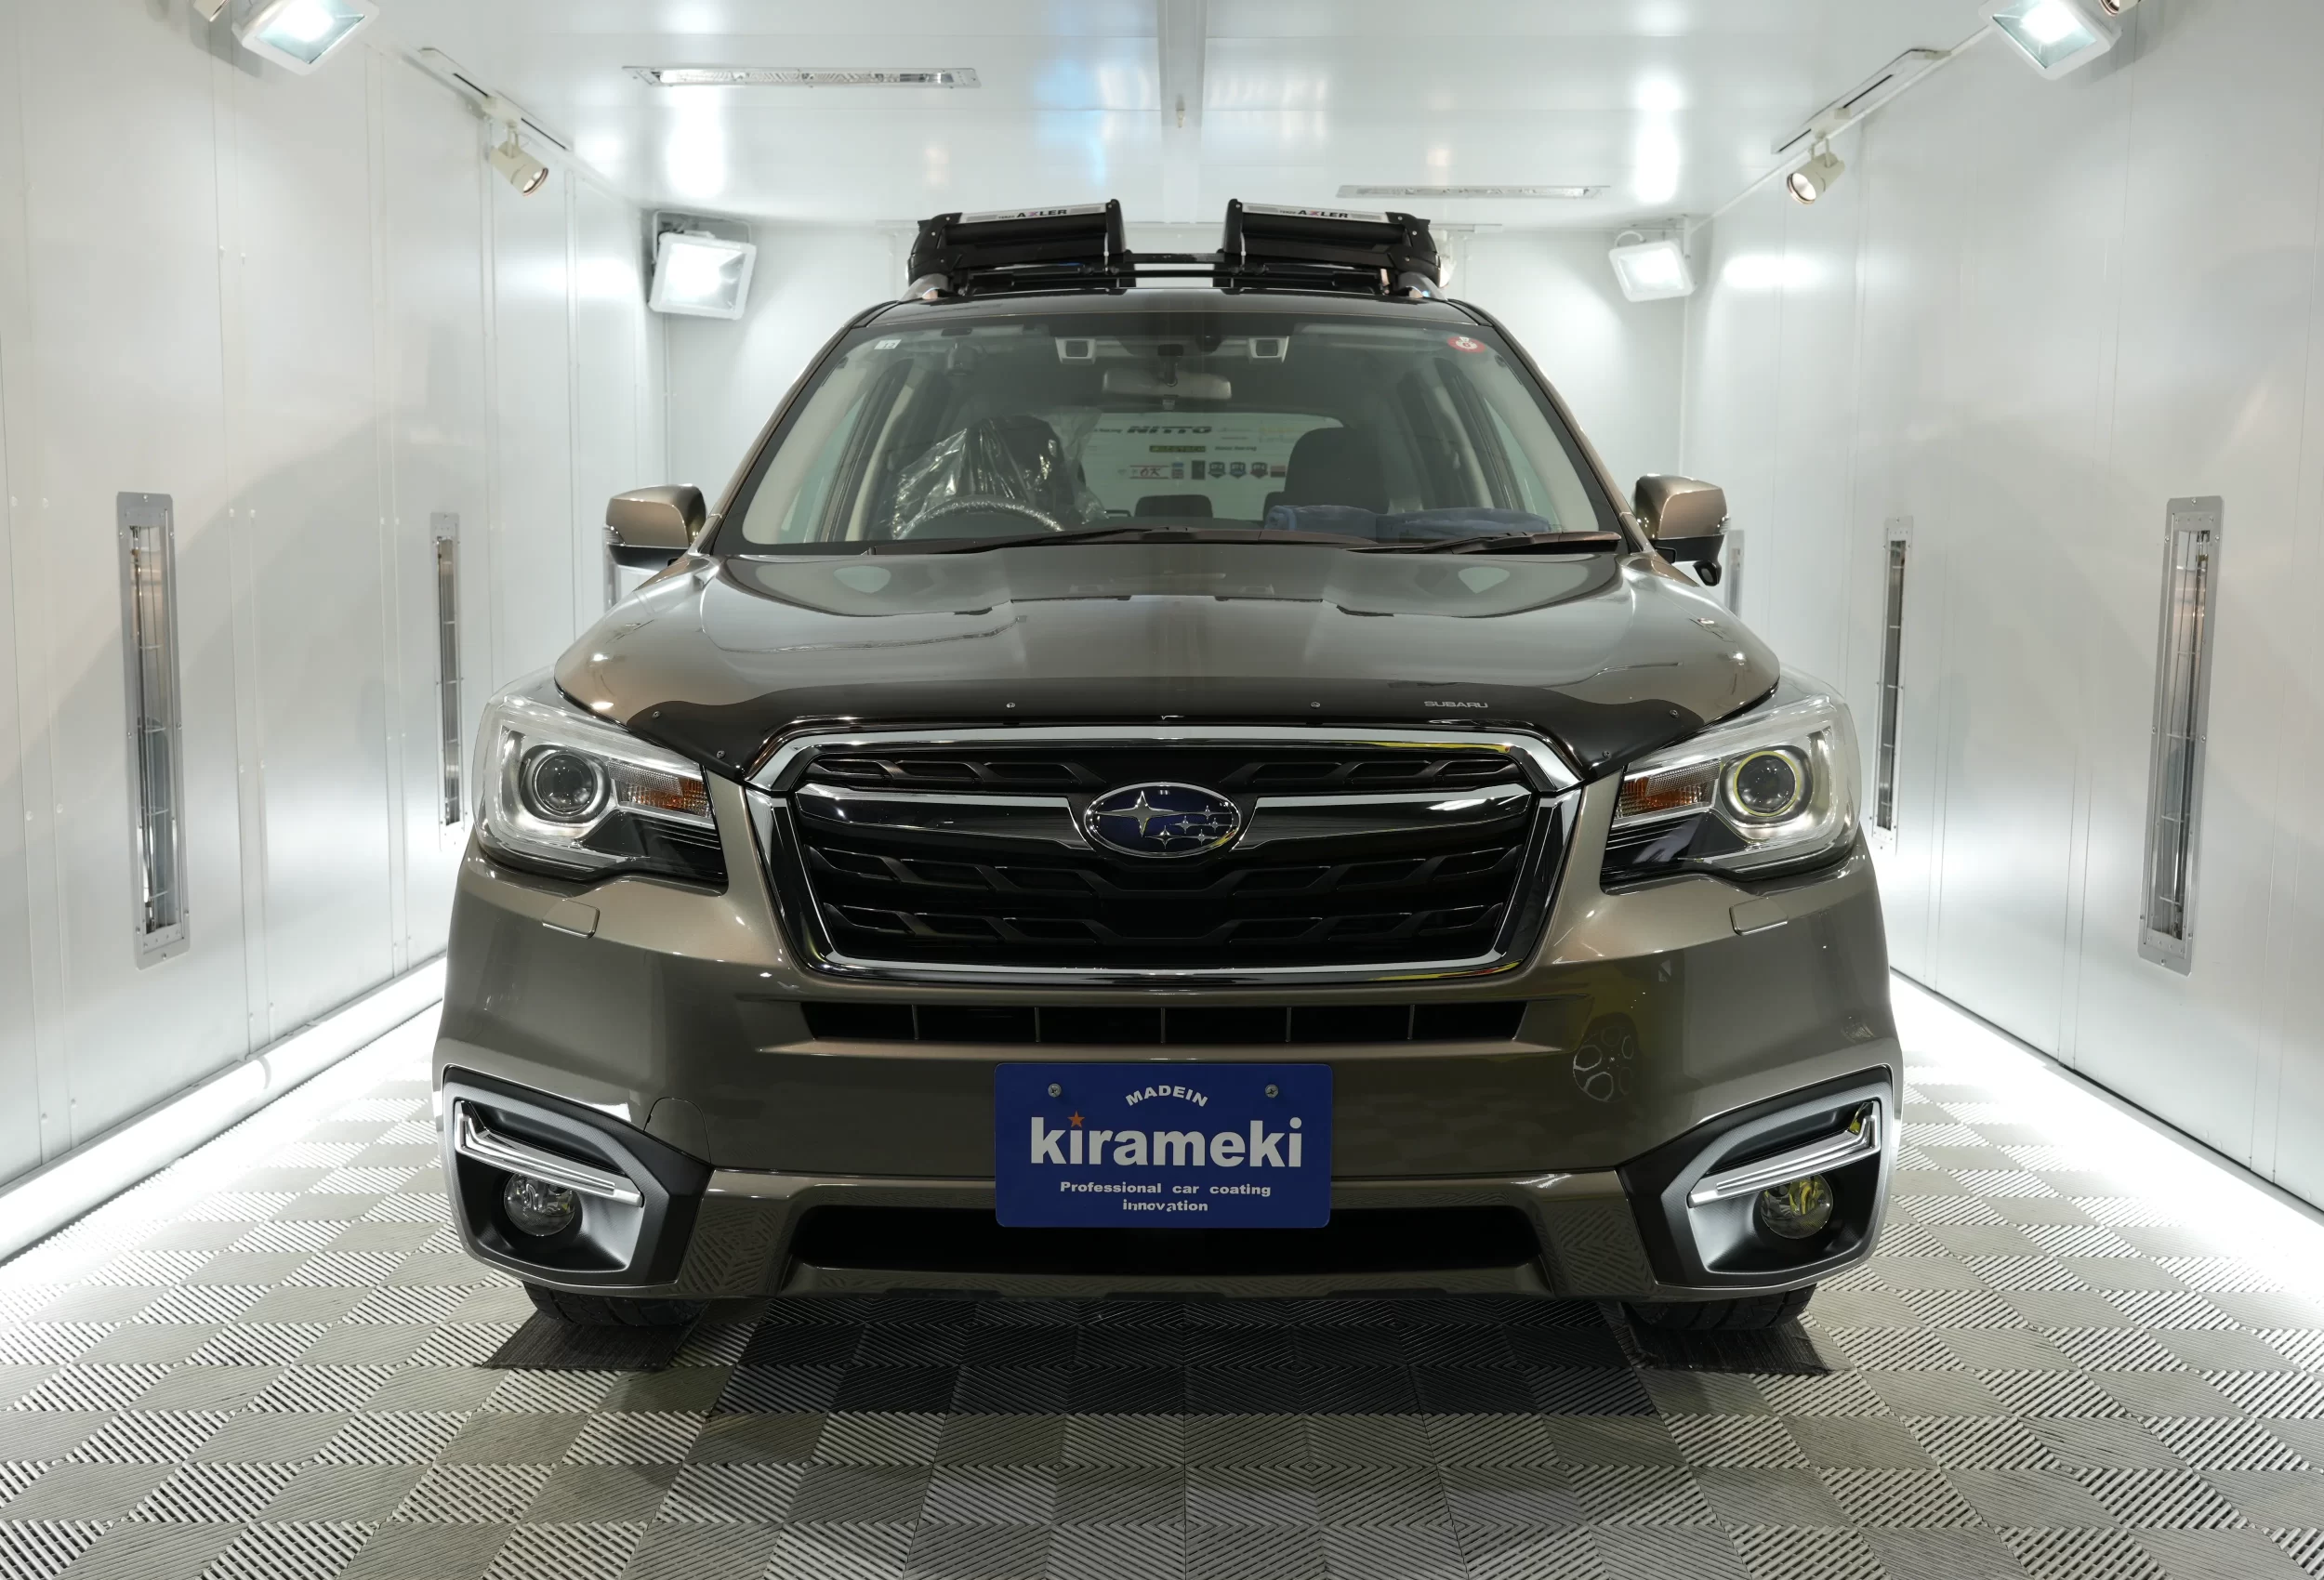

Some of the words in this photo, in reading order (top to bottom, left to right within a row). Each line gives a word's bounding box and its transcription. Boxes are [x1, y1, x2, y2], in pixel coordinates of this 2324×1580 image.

[1016, 209, 1067, 218] AXLER
[1298, 210, 1349, 218] AXLER
[1127, 426, 1212, 434] NITTO
[1126, 1085, 1208, 1107] MADEIN
[1031, 1112, 1301, 1167] kirameki
[1060, 1181, 1162, 1193] Professional
[1172, 1184, 1200, 1194] car
[1209, 1183, 1272, 1197] coating
[1122, 1199, 1208, 1213] innovation
